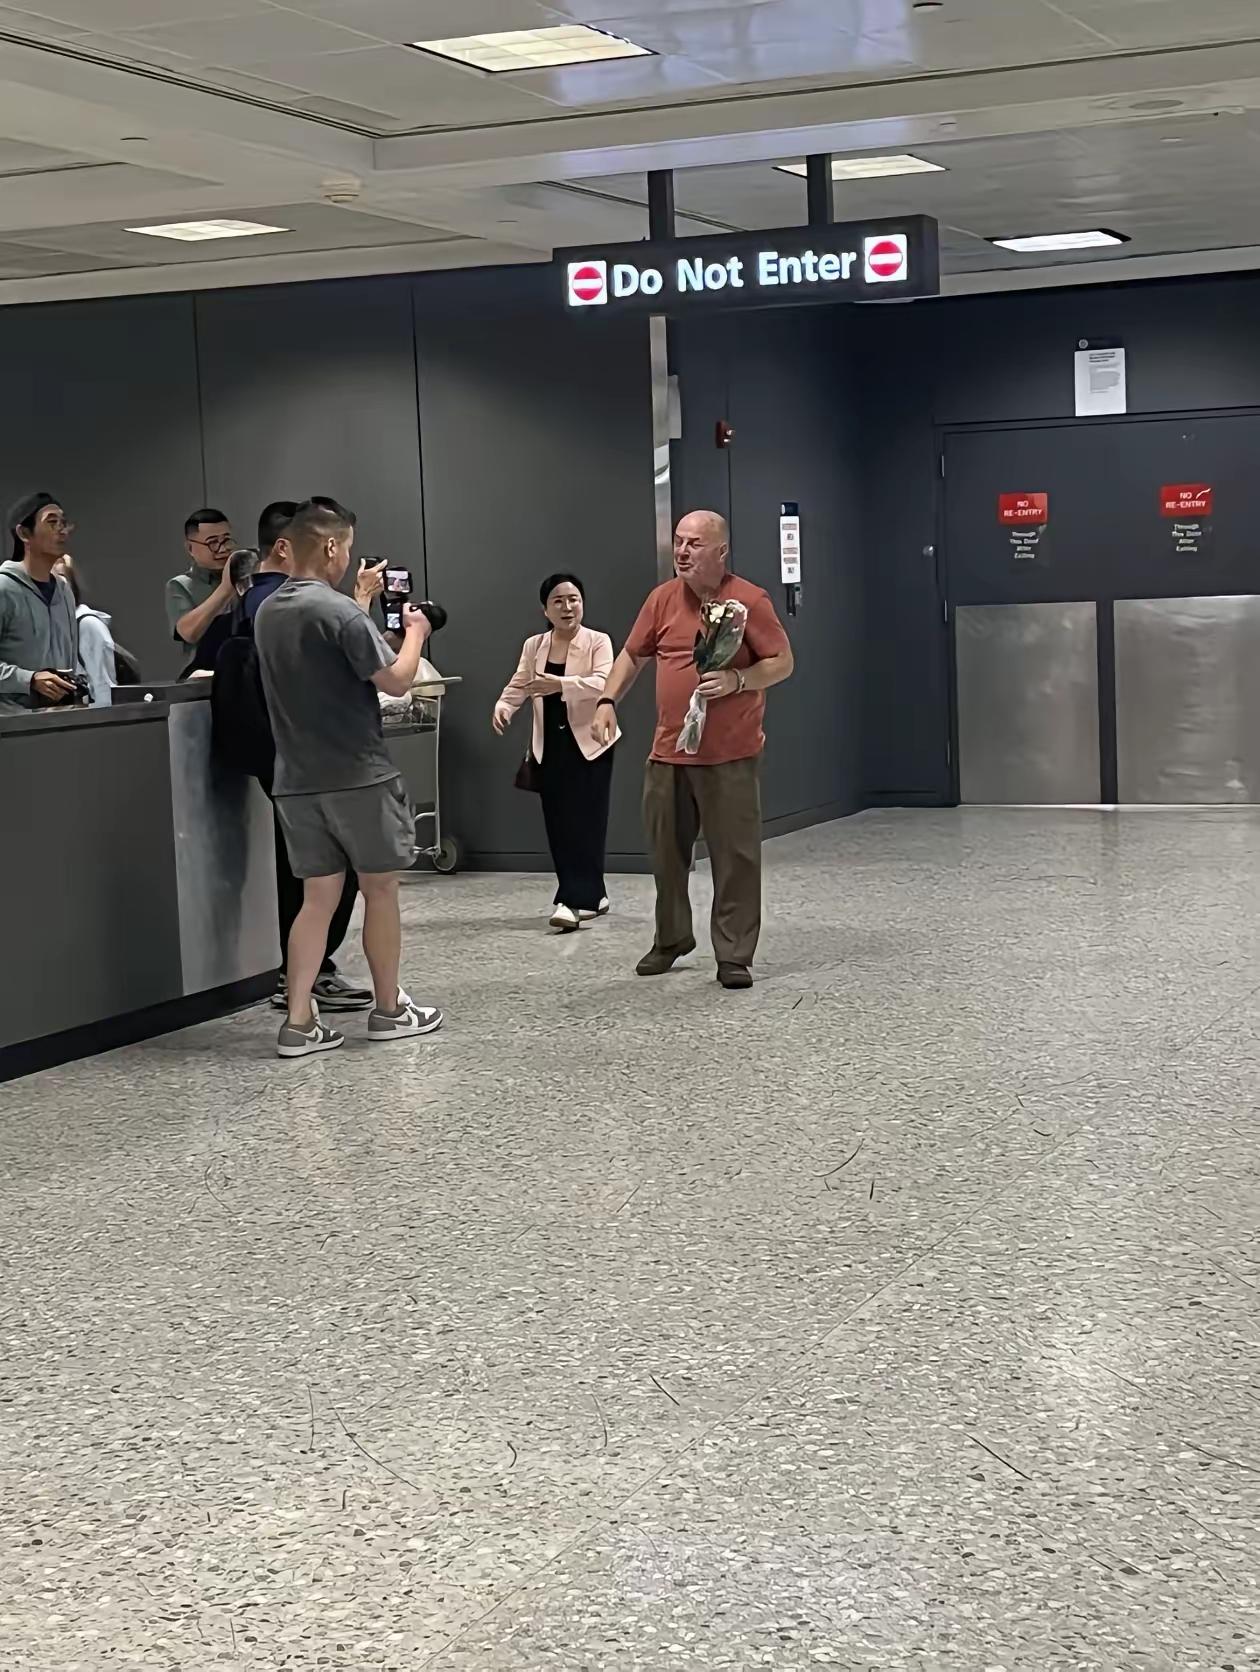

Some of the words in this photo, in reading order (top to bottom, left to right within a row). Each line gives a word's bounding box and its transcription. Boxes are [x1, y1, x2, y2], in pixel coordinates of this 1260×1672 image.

[612, 263, 663, 298] Do
[677, 256, 744, 292] Not
[758, 250, 857, 286] Enter
[1180, 492, 1193, 500] NO
[1016, 500, 1029, 508] NO
[1165, 500, 1206, 509] RE-ENTRY
[1003, 508, 1042, 517] RE-ENTRY
